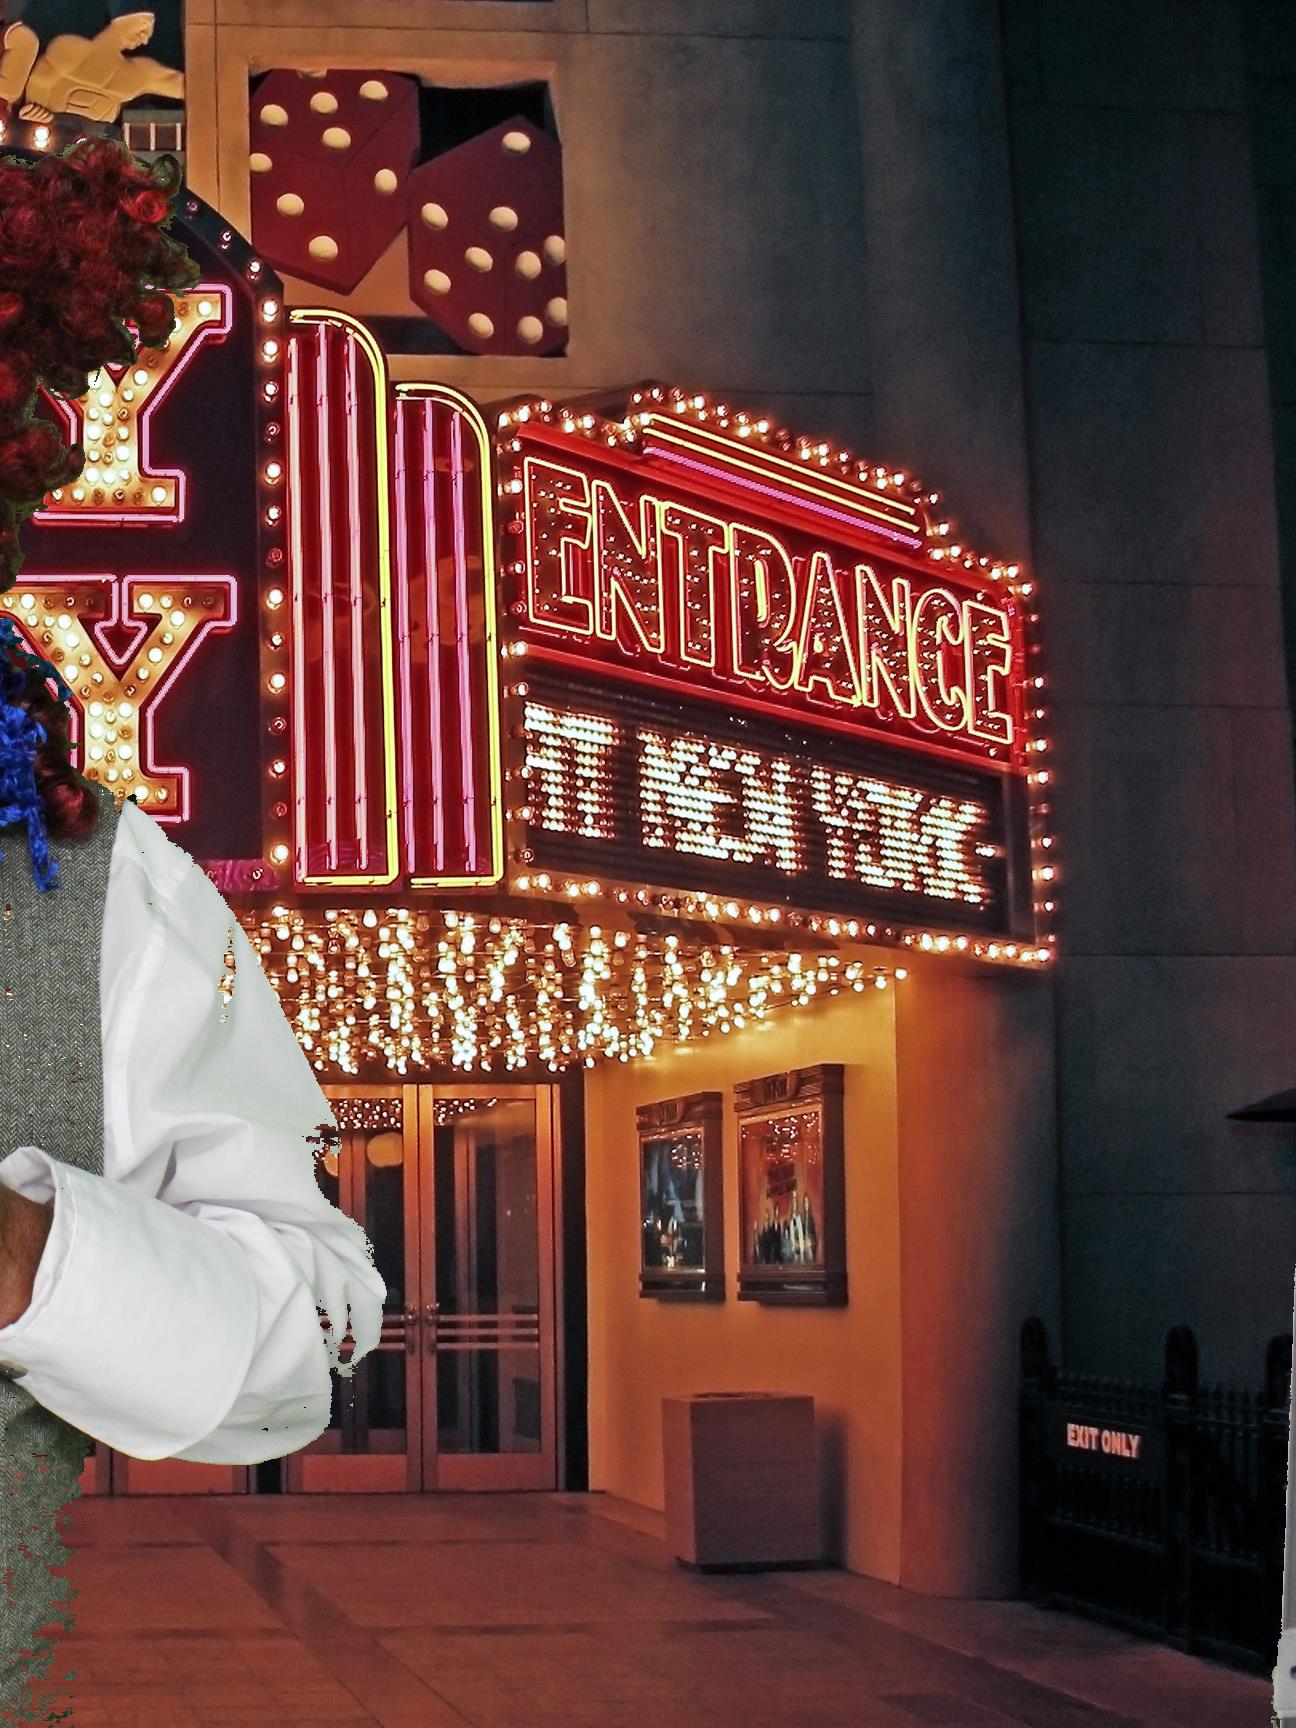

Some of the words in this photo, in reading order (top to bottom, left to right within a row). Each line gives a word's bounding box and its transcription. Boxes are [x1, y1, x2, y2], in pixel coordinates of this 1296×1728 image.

[523, 456, 1014, 744] ENTRANCE
[1067, 1422, 1100, 1451] EXIT
[1101, 1429, 1143, 1459] ONLY
